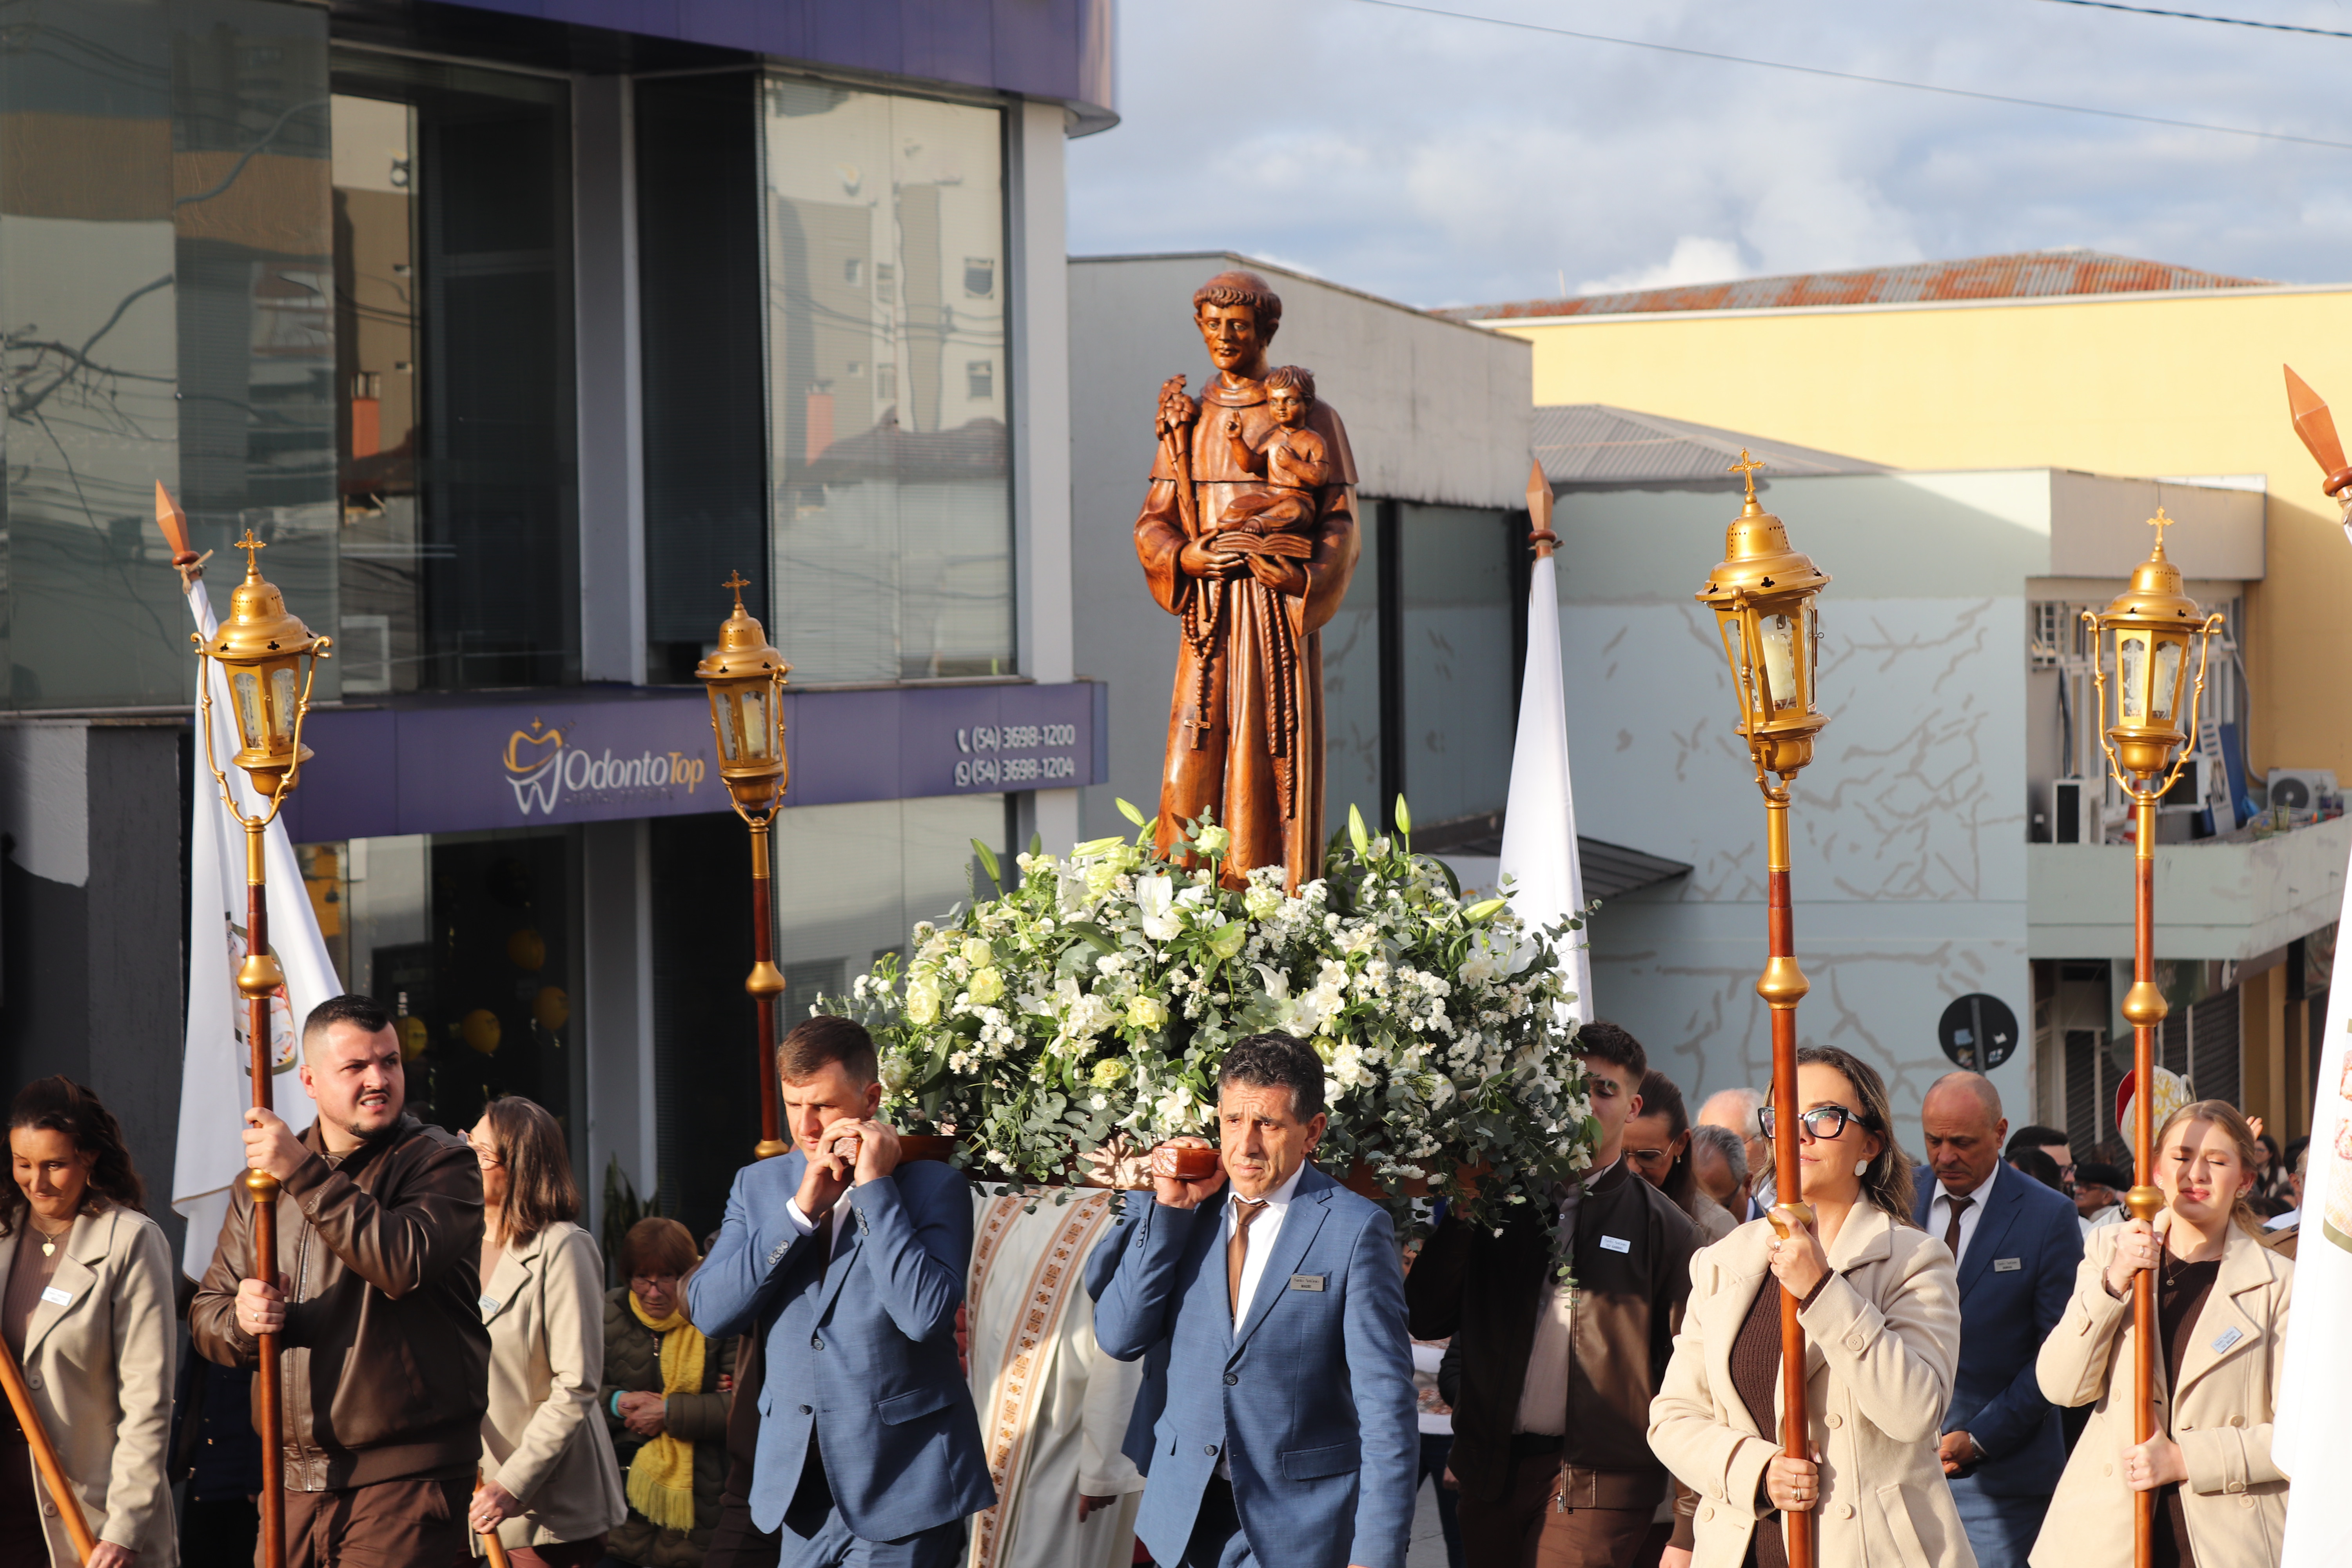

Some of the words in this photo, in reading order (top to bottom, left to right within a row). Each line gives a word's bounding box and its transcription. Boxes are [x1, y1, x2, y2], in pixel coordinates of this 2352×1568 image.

[972, 725, 1001, 753] (54)
[564, 748, 704, 794] OdontoTop
[971, 757, 1000, 786] (54)
